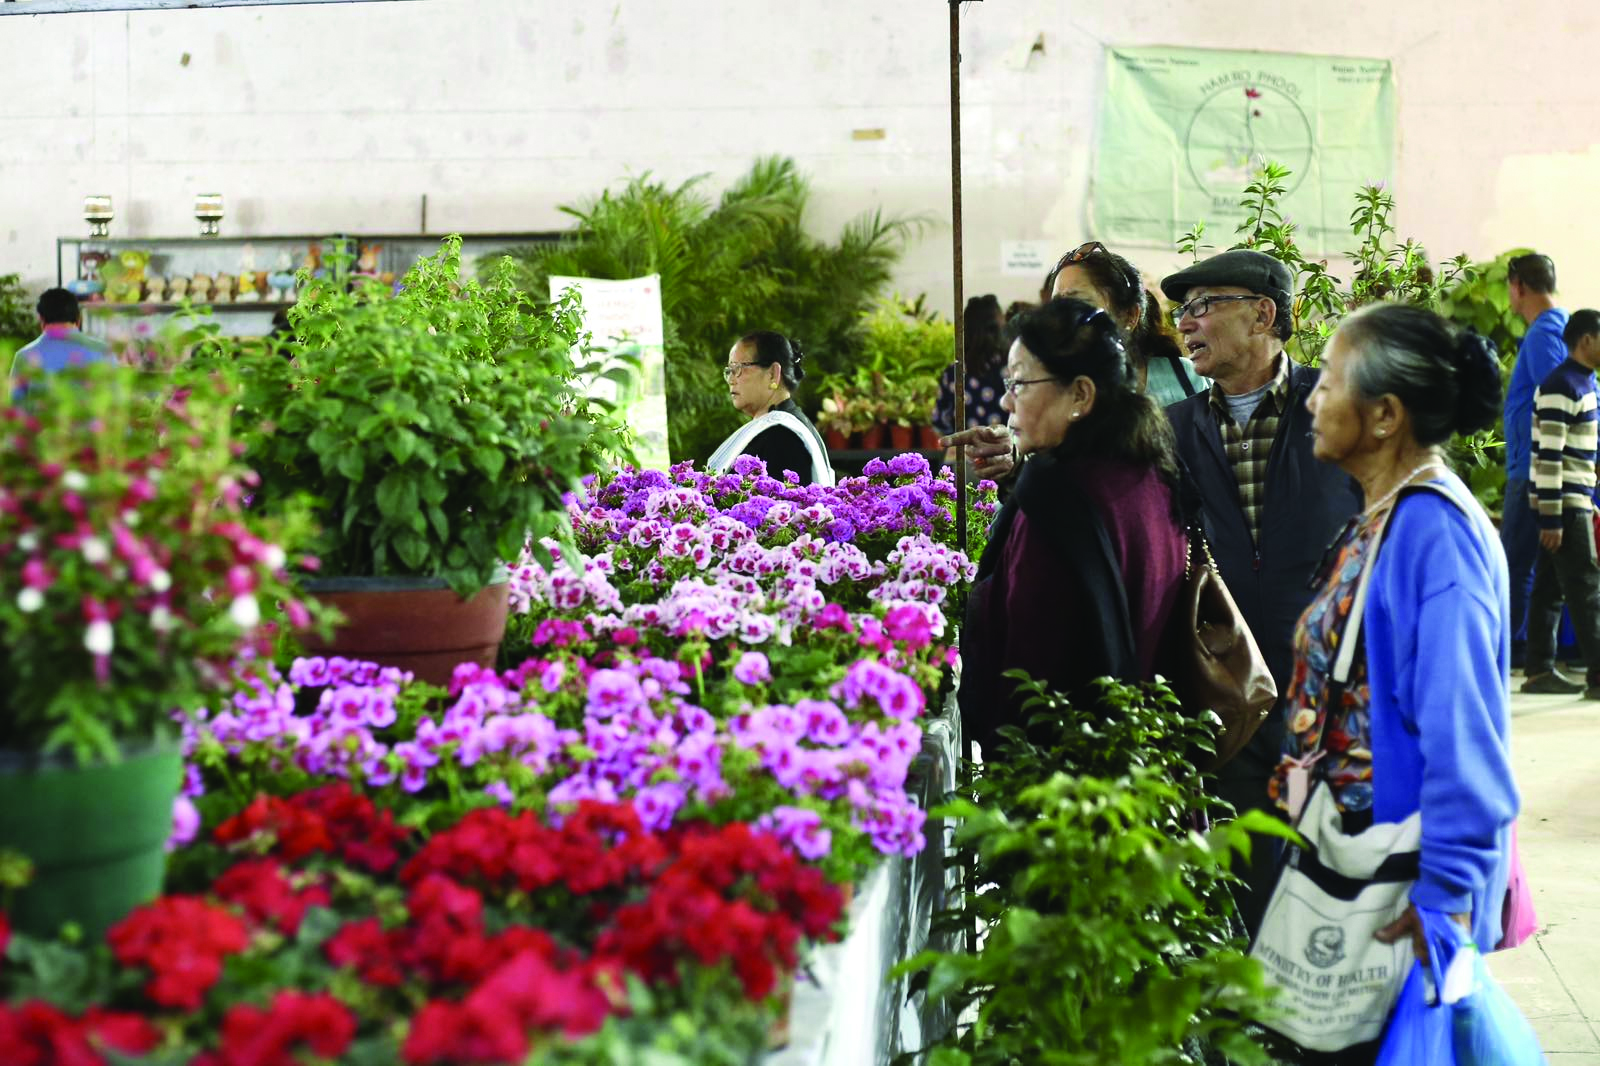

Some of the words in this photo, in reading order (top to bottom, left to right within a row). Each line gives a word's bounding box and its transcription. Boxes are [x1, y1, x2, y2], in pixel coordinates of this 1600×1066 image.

[1200, 70, 1251, 94] HAMRO
[1258, 70, 1303, 99] PHOOL
[1259, 940, 1312, 984] MINISTRY
[1316, 974, 1333, 988] OF
